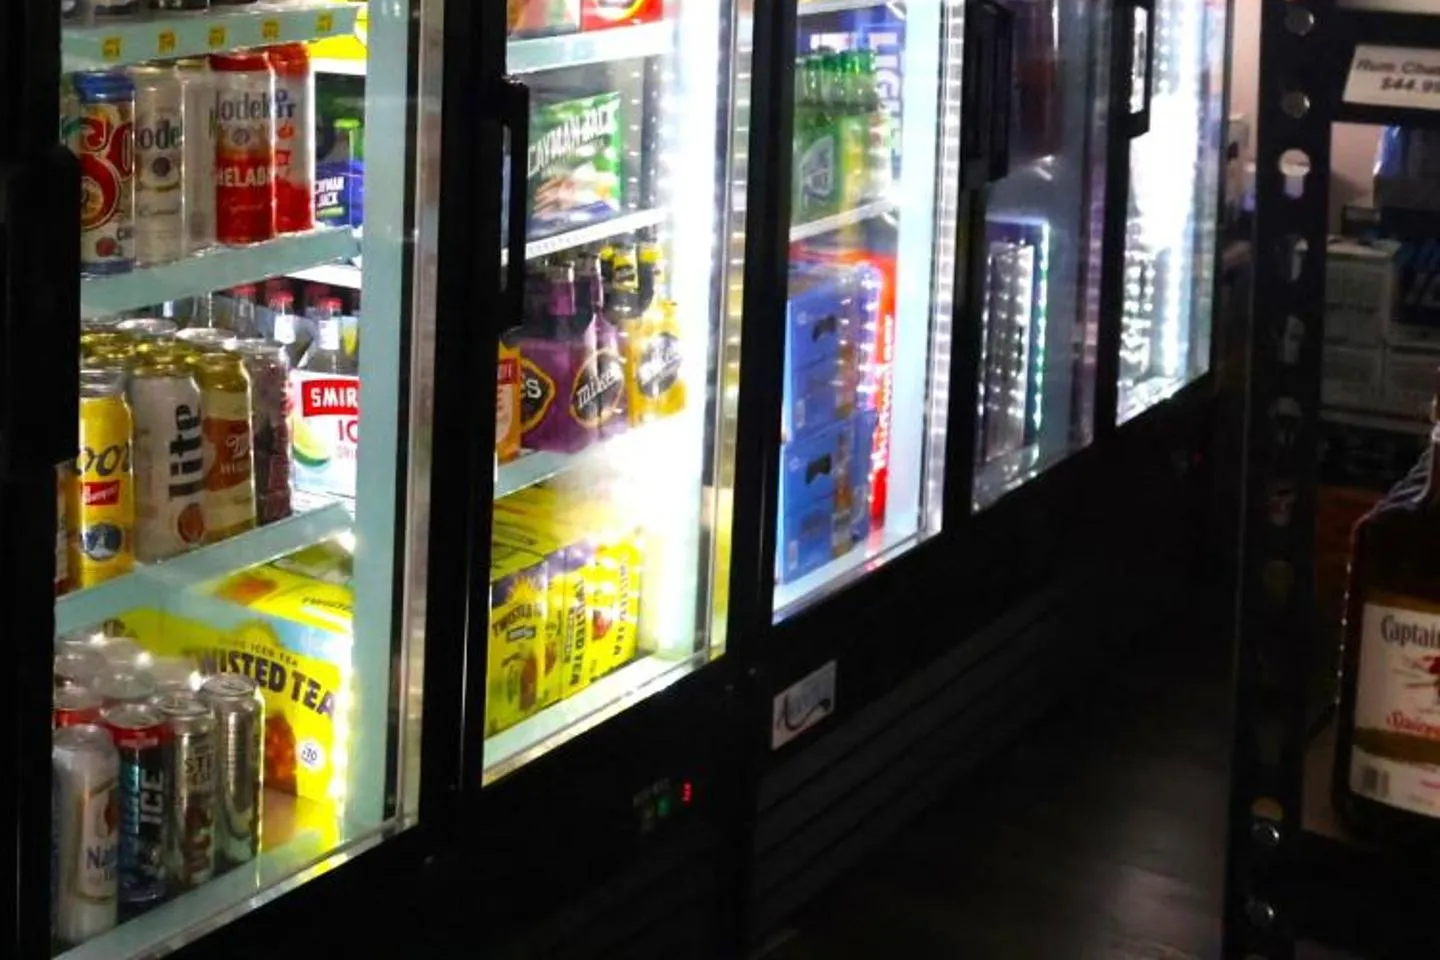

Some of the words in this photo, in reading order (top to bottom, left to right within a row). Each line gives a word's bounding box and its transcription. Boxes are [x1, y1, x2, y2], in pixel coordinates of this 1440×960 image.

[310, 390, 358, 409] SMIR
[168, 403, 202, 503] lite
[184, 647, 288, 694] ISTED
[291, 669, 335, 715] TEA
[140, 768, 164, 824] ICE
